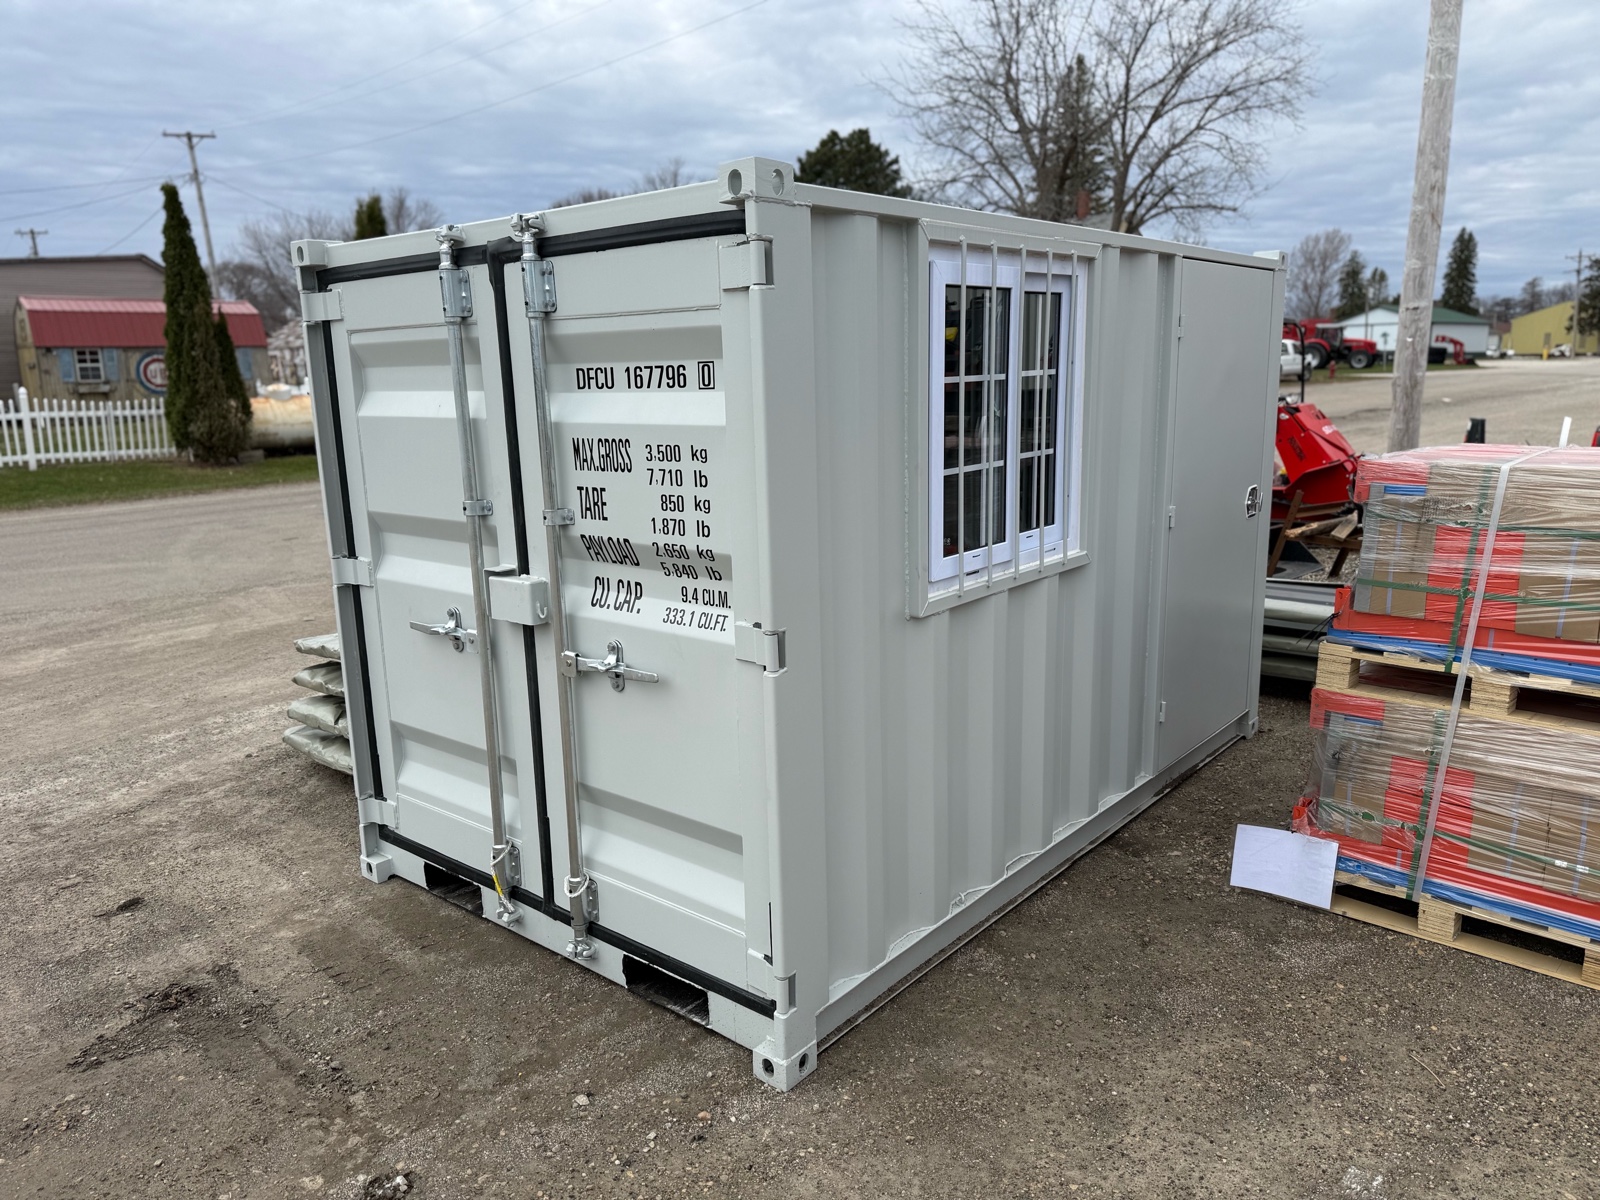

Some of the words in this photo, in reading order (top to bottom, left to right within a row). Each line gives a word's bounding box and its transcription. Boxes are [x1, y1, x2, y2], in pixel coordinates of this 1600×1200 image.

[576, 366, 615, 390] DFCU
[624, 364, 687, 389] 167796
[690, 445, 708, 463] kg
[693, 469, 708, 488] lb
[577, 486, 608, 521] TARE
[660, 494, 685, 512] 850
[694, 495, 711, 514] kg
[696, 520, 711, 538] lb
[580, 534, 640, 567] PAYLOAD
[696, 544, 715, 562] kg
[705, 565, 723, 582] lb
[613, 578, 643, 614] CAP.
[681, 586, 699, 604] 9.4
[662, 606, 695, 628] 333.1
